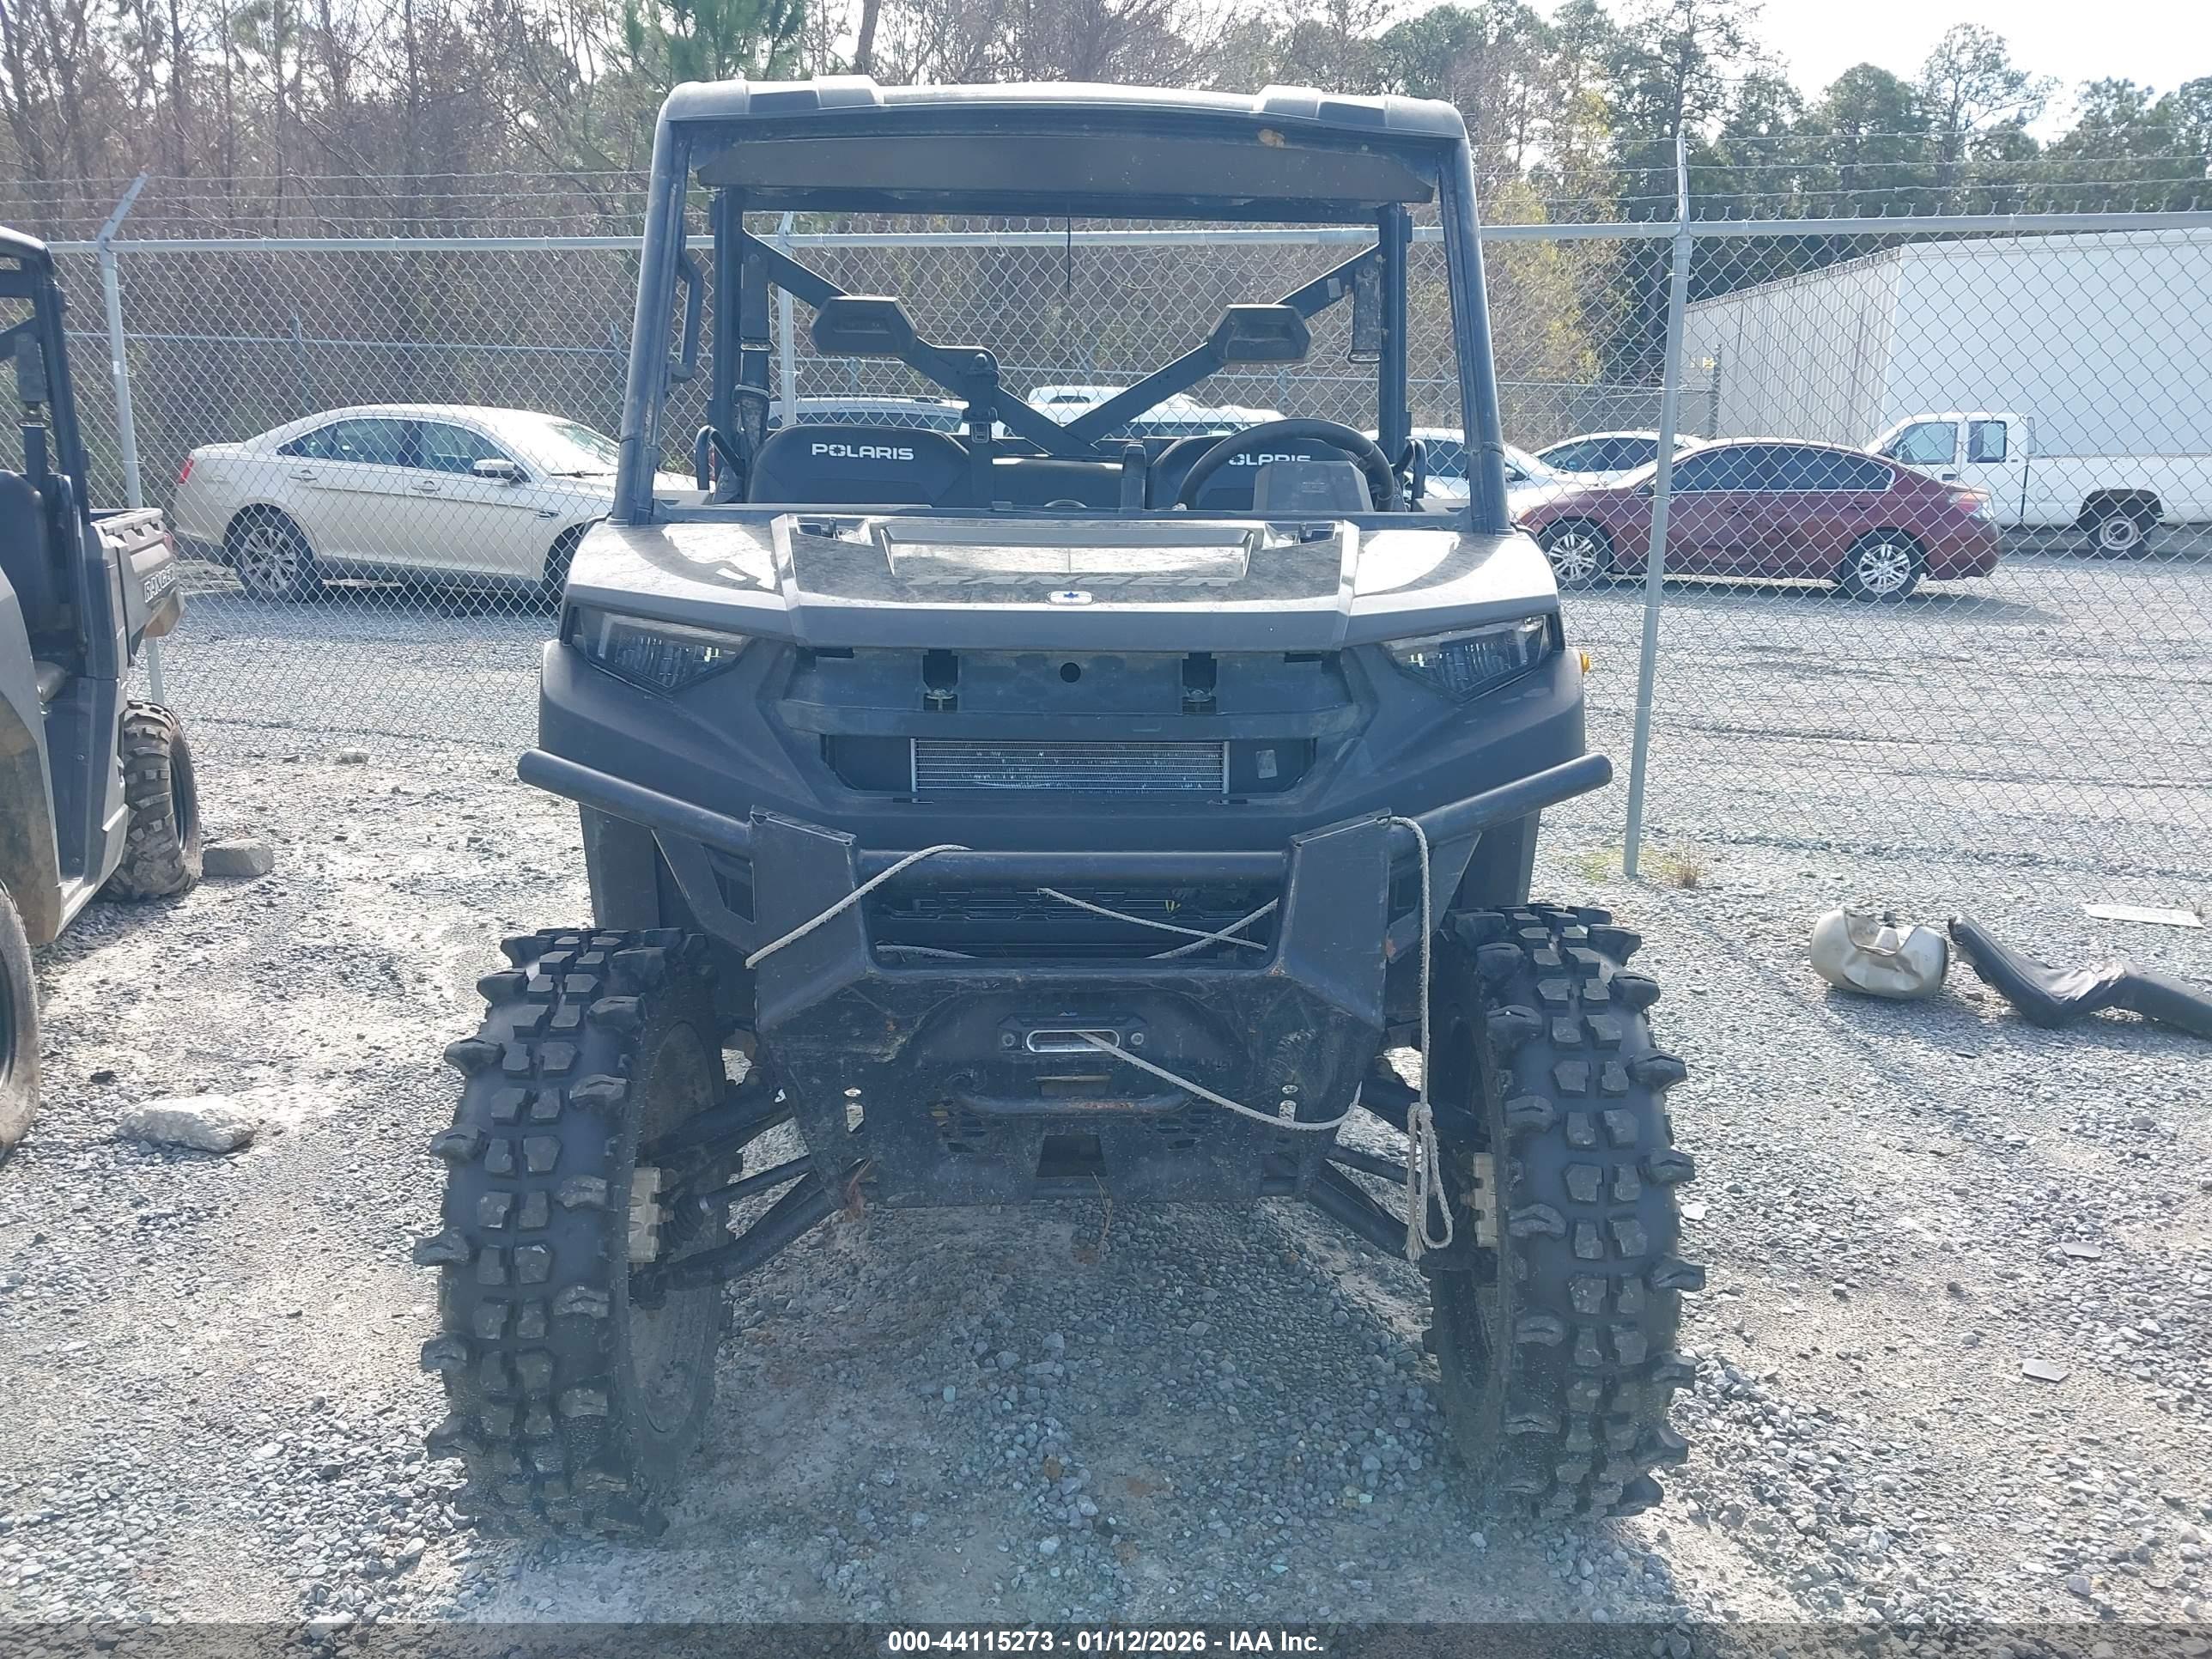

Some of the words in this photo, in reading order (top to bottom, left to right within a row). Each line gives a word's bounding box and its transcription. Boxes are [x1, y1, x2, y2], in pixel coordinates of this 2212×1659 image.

[811, 443, 914, 460] POLARIS
[1229, 453, 1311, 466] OLARIS
[906, 576, 1241, 586] RANGER
